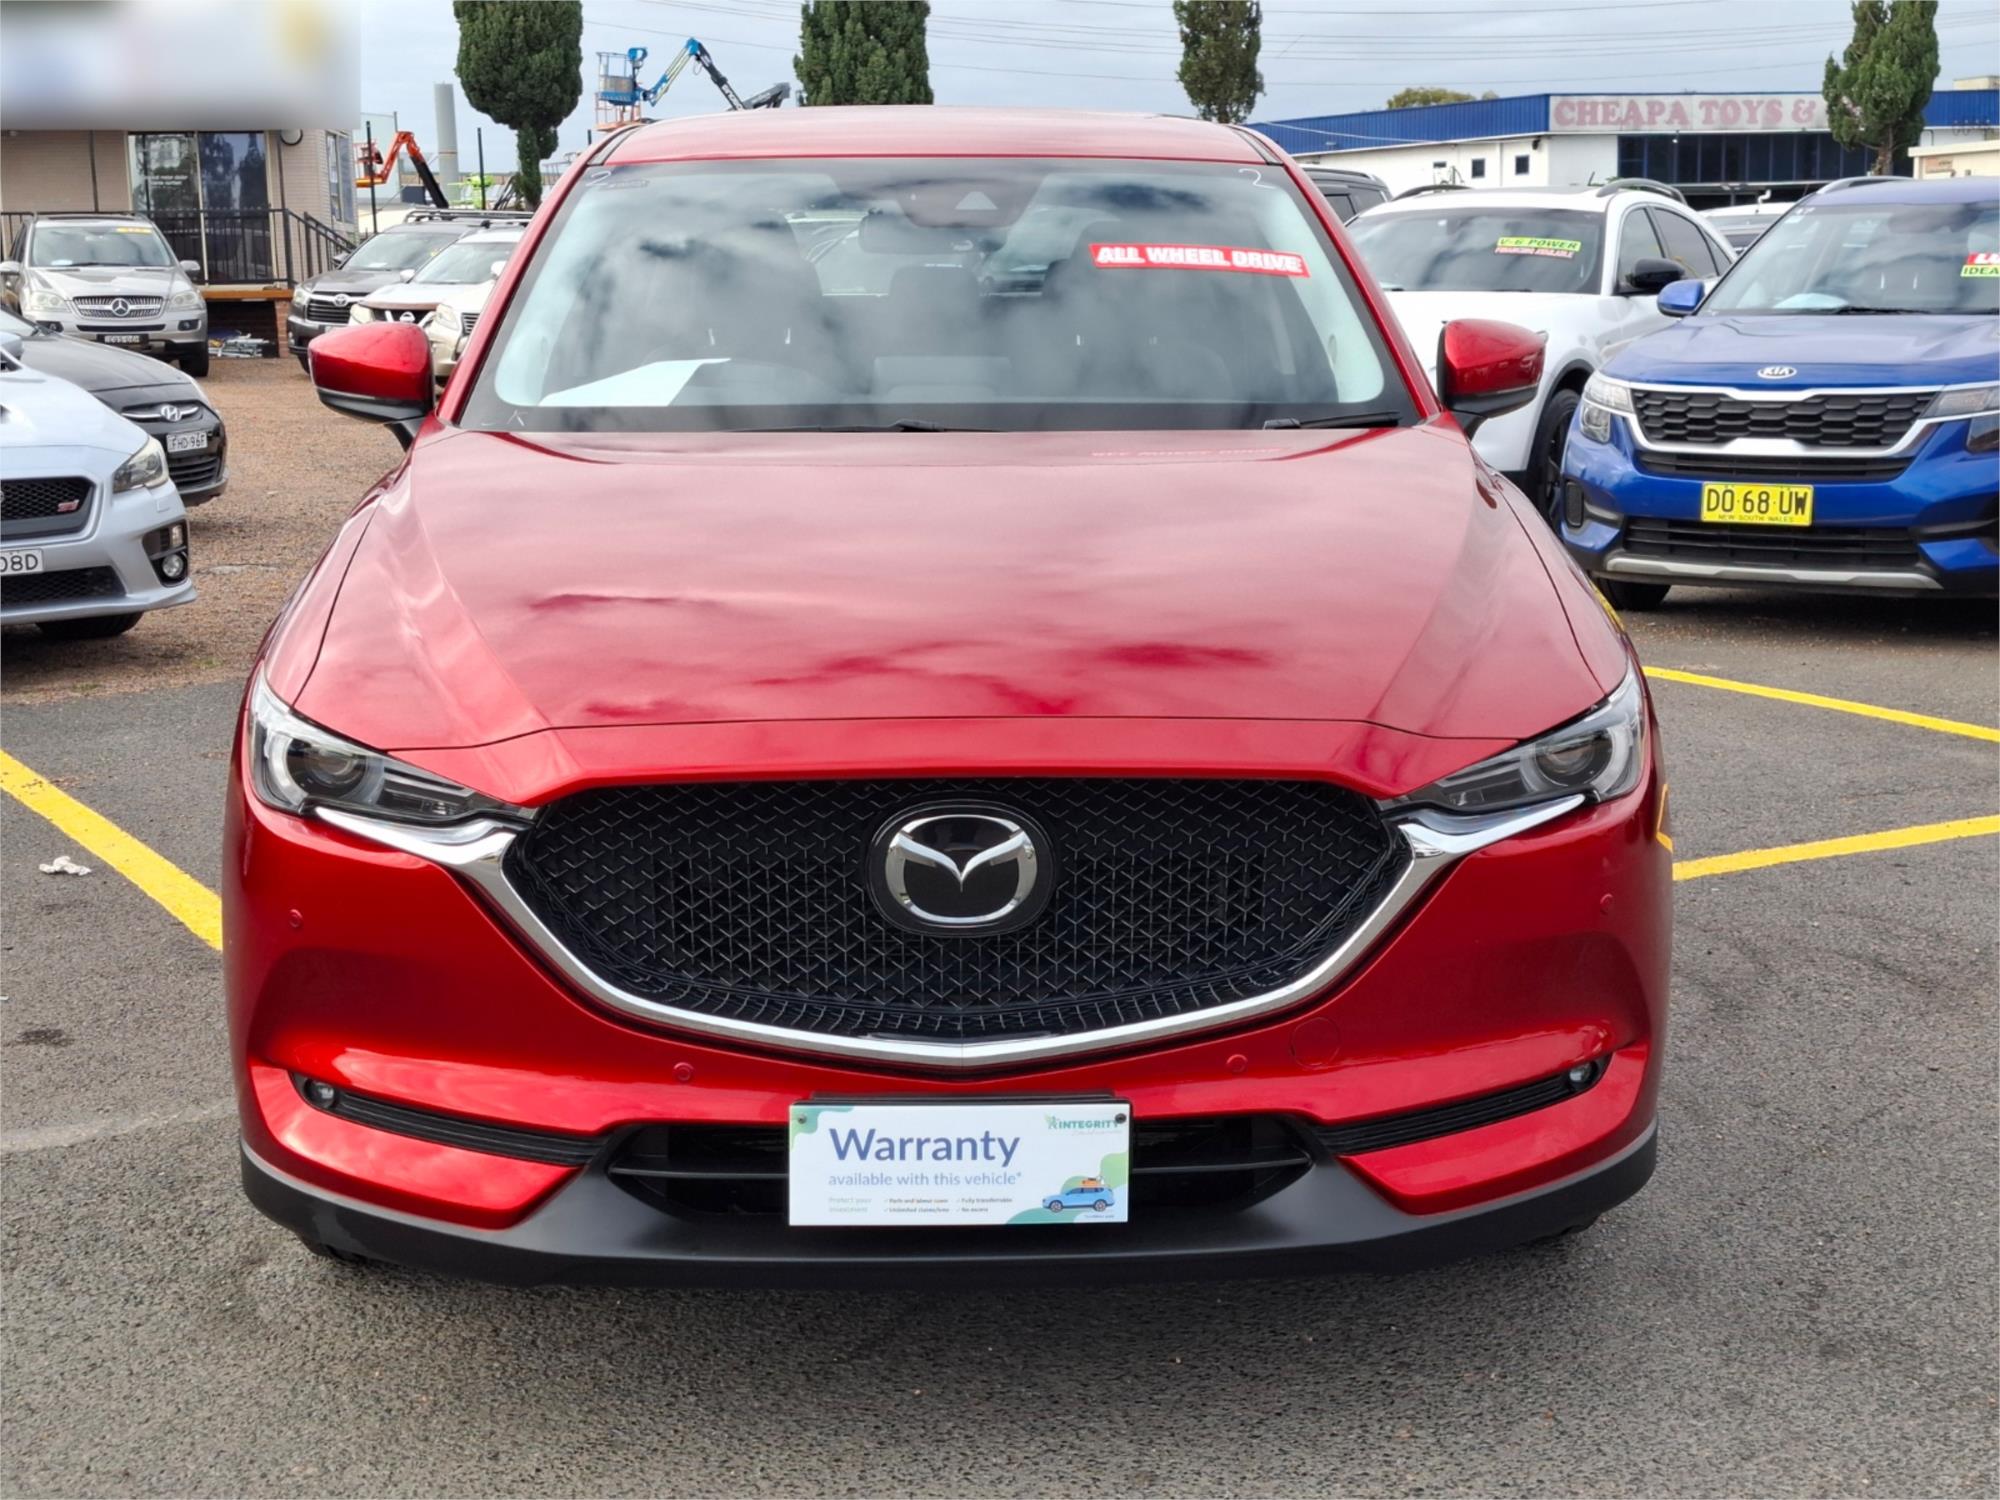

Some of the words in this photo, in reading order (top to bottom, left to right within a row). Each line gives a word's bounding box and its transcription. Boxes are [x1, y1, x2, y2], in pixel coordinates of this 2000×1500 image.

[1553, 99, 1690, 126] CHEAPA
[1699, 98, 1783, 125] TOYS
[1791, 98, 1816, 124] &
[1528, 239, 1578, 249] POWER
[1096, 246, 1145, 264] ALL
[1145, 246, 1231, 267] WHEEL
[1231, 250, 1303, 273] DRIVE
[1761, 366, 1790, 376] KIA
[1738, 514, 1764, 522] SOUTH
[828, 1128, 1021, 1168] Warranty
[828, 1172, 893, 1186] available
[896, 1172, 929, 1186] with
[934, 1172, 961, 1186] this
